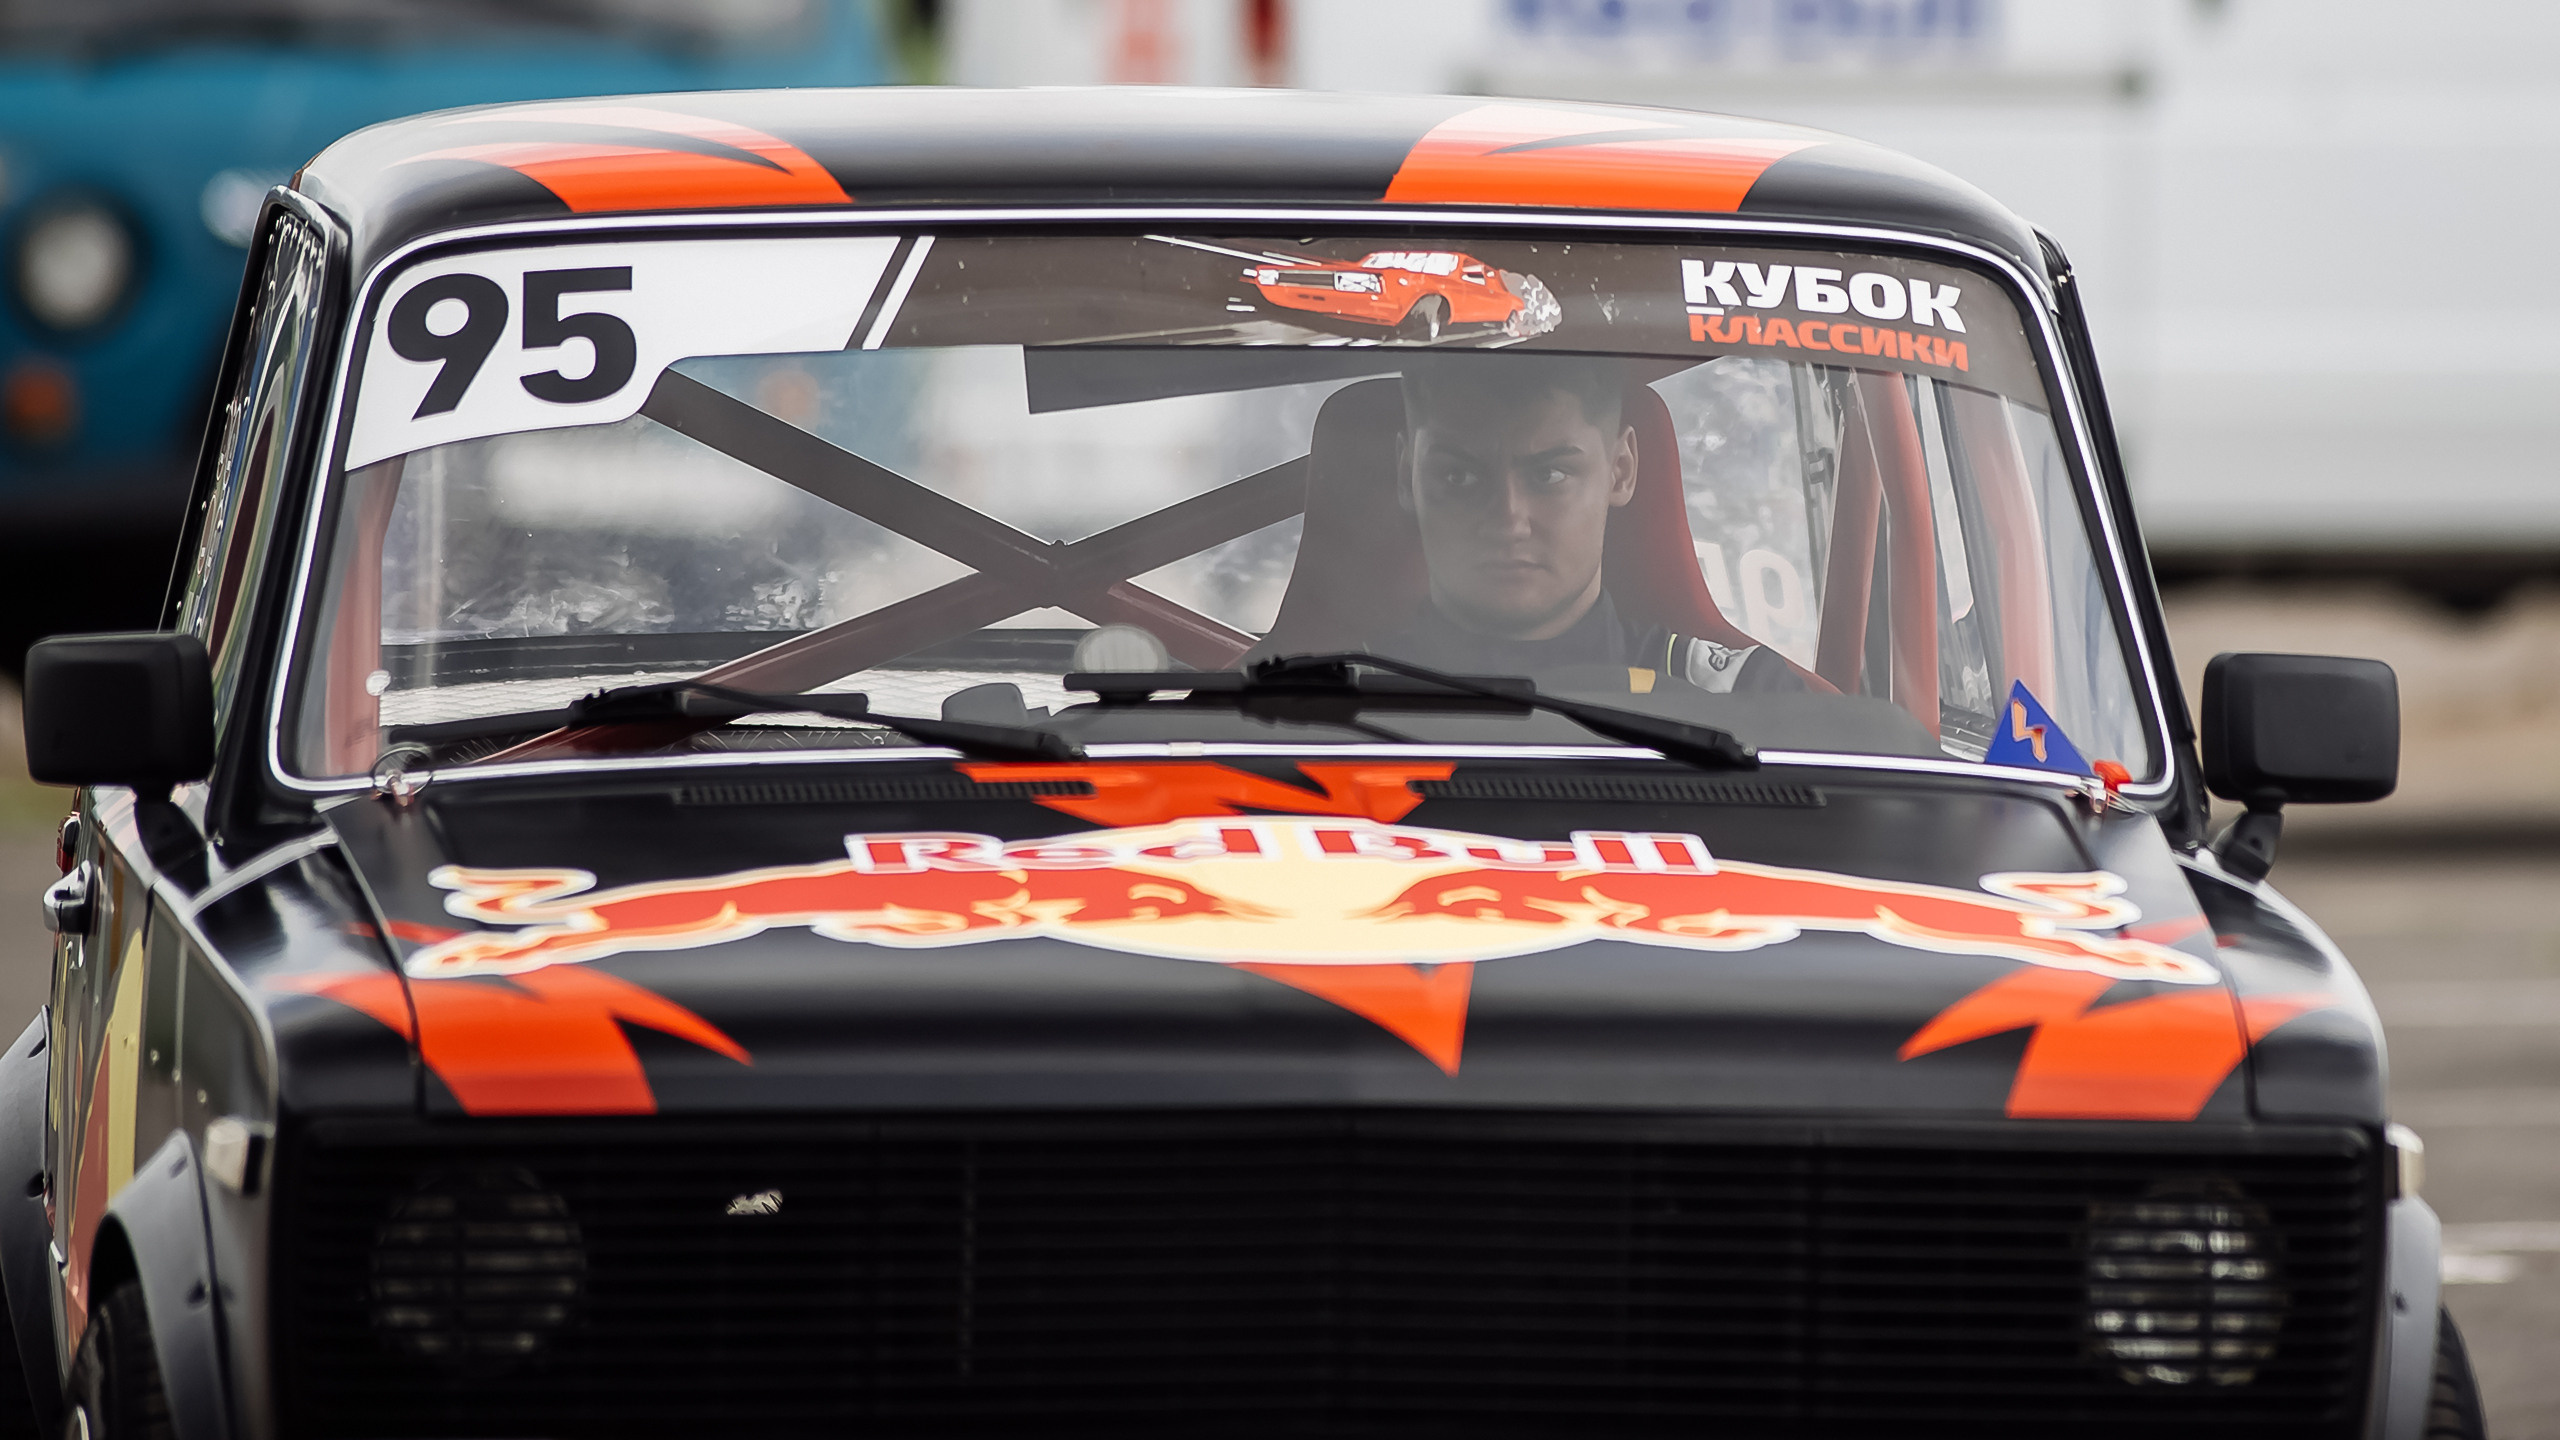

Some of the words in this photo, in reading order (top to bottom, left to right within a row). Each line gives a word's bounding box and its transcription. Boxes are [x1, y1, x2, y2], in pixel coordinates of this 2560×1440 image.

[1681, 259, 1967, 333] КУБОК
[387, 265, 637, 421] 95
[1688, 314, 1969, 372] КЛАССИКИ
[845, 822, 1281, 874] Red
[1294, 822, 1718, 875] Bull
